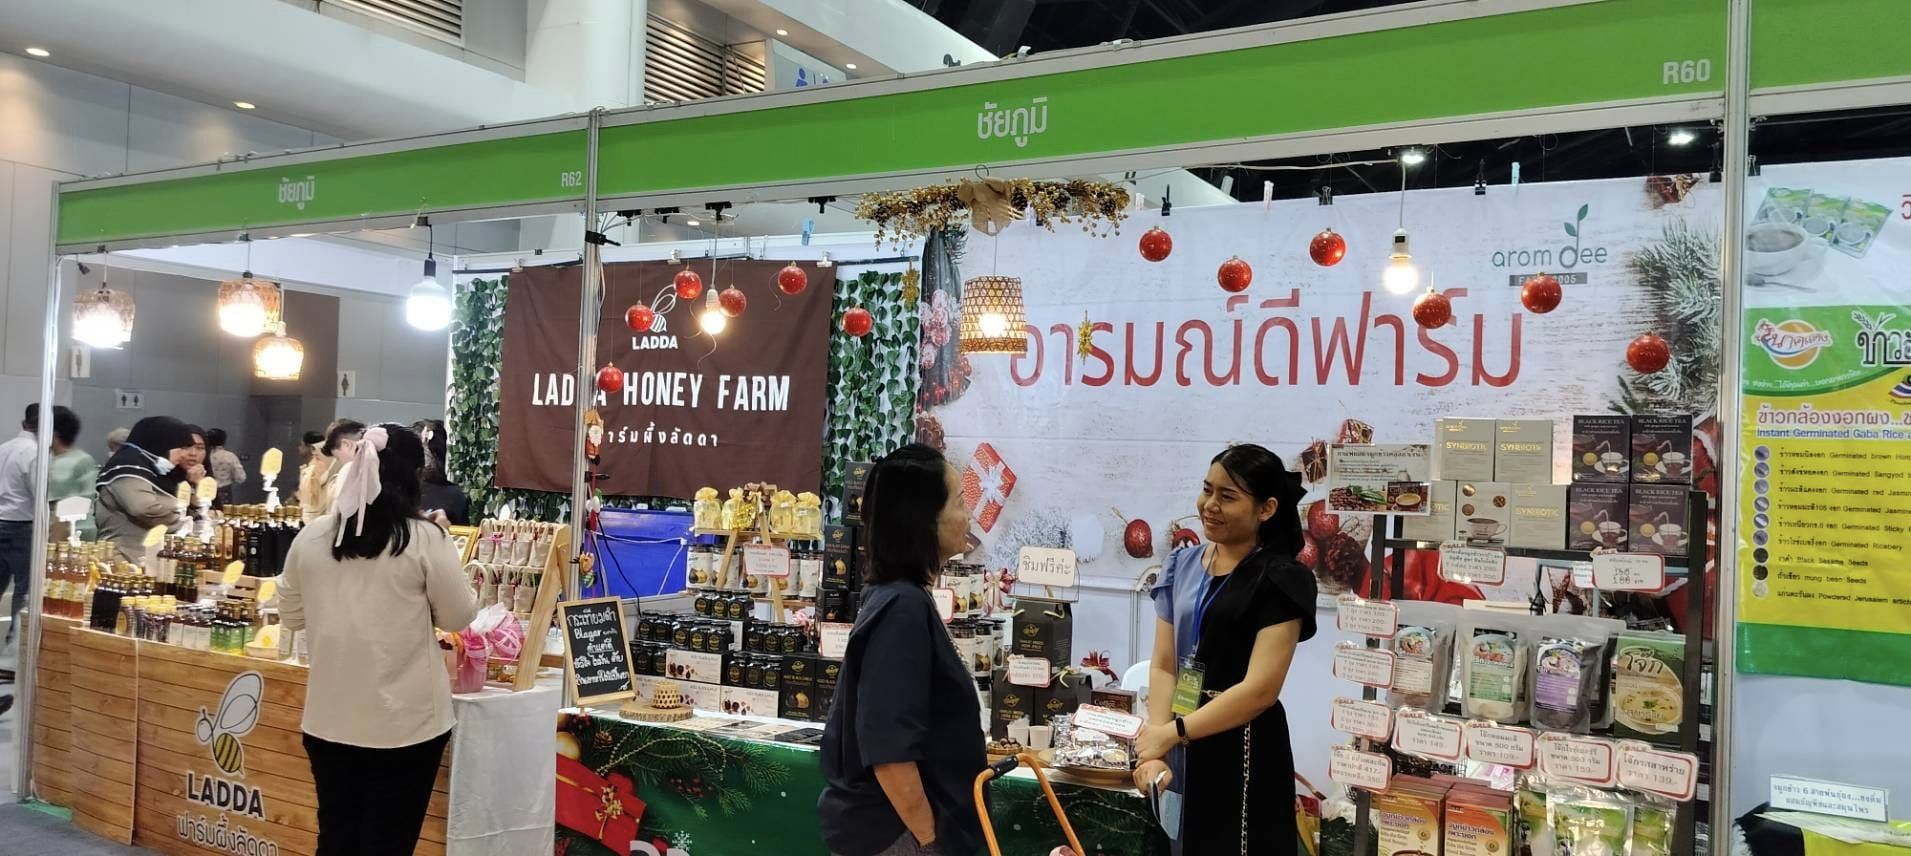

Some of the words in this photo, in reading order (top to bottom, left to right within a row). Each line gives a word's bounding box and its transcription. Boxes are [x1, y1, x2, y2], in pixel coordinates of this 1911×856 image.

[1663, 59, 1711, 85] R60
[977, 96, 1048, 147] ชัยภูมิ
[561, 171, 582, 187] R62
[279, 175, 315, 210] ชัยภูมิ
[1492, 249, 1552, 268] arom
[632, 335, 679, 351] LADDA
[1010, 287, 1523, 387] อารมณ์ดีฟาร์ม
[623, 371, 703, 408] HONEY
[717, 374, 790, 412] FARM
[607, 420, 719, 448] าร์มผึ้งลัดดา
[1757, 428, 1790, 438] Instant
[1793, 429, 1850, 439] Germinated
[1853, 429, 1879, 439] Gaba
[1883, 430, 1905, 439] Rice
[1830, 451, 1867, 459] Germinated
[1871, 452, 1892, 460] brown
[1832, 469, 1871, 478] Germinated
[1831, 487, 1869, 496] Germinated
[1842, 505, 1882, 514] Germinated
[1841, 523, 1881, 532] Germinated
[1830, 540, 1869, 549] Germinated
[1022, 555, 1072, 576] ชิมฟรีค่ะ
[1818, 558, 1844, 566] Sesame
[1848, 559, 1869, 567] Seeds
[1846, 576, 1867, 584] Seeds
[1818, 592, 1851, 601] Powdered
[1854, 595, 1889, 603] Jerusalem
[1625, 649, 1664, 674] โจ๊ก
[187, 773, 264, 818] LADDA
[177, 811, 280, 856] ฟาร์มผึ้งลัดดา
